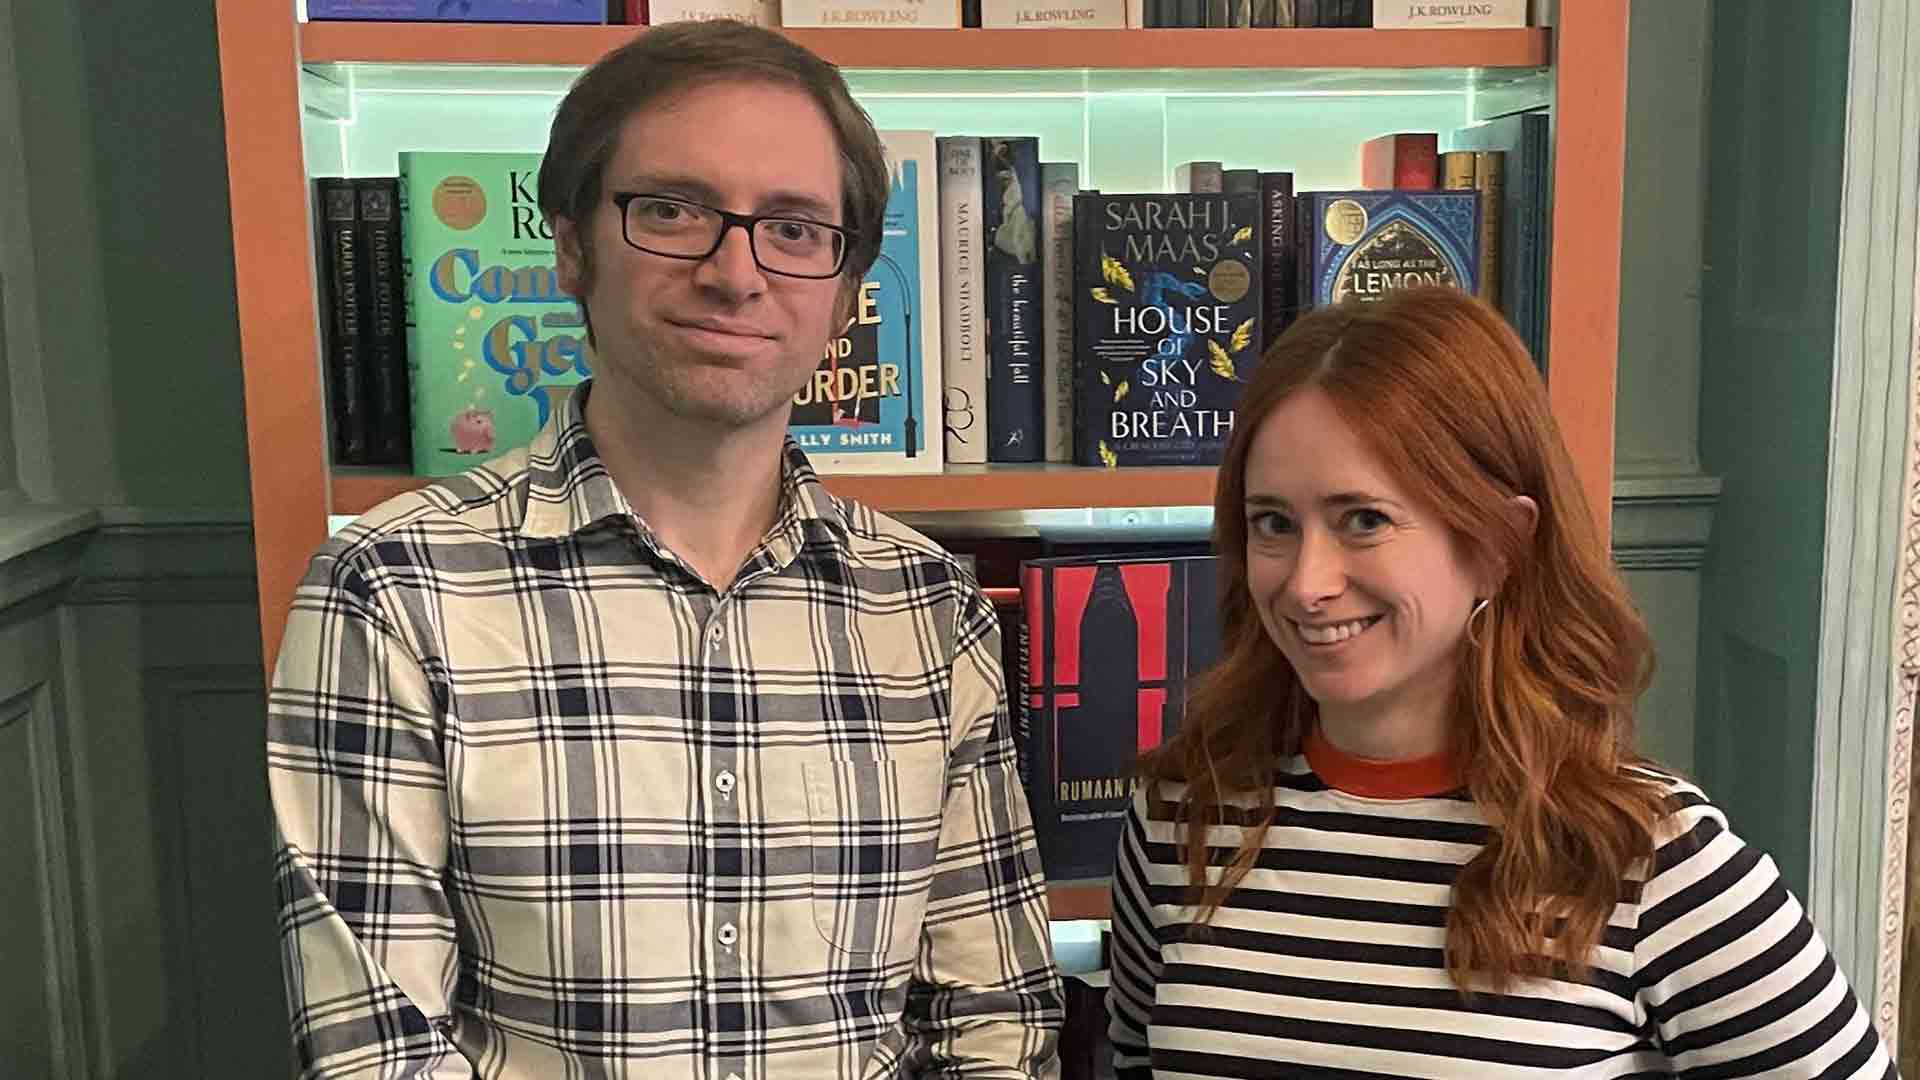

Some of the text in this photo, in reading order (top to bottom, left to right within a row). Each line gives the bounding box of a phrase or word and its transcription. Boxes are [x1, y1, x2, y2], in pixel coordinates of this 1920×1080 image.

[1035, 8, 1096, 22] ROWLING
[1430, 4, 1493, 17] ROWLING
[1104, 200, 1210, 232] SARAH
[1271, 190, 1284, 247] ASKING
[1125, 233, 1220, 263] MAAS
[430, 249, 577, 303] Com
[957, 202, 973, 362] MAURICE SHADBOLT
[1354, 271, 1441, 293] LEMON
[1008, 274, 1031, 384] the beautiful fall
[1113, 305, 1231, 335] HOUSE
[824, 338, 852, 359] ND
[1157, 338, 1184, 356] OF
[793, 363, 902, 406] URDER
[1142, 359, 1203, 386] SKY
[1151, 390, 1197, 408] AND
[1111, 410, 1235, 439] BREATH
[799, 432, 893, 447] LLY SMITH
[1018, 623, 1031, 739] ENTITLEMENT
[1060, 778, 1124, 801] RUMAAN
